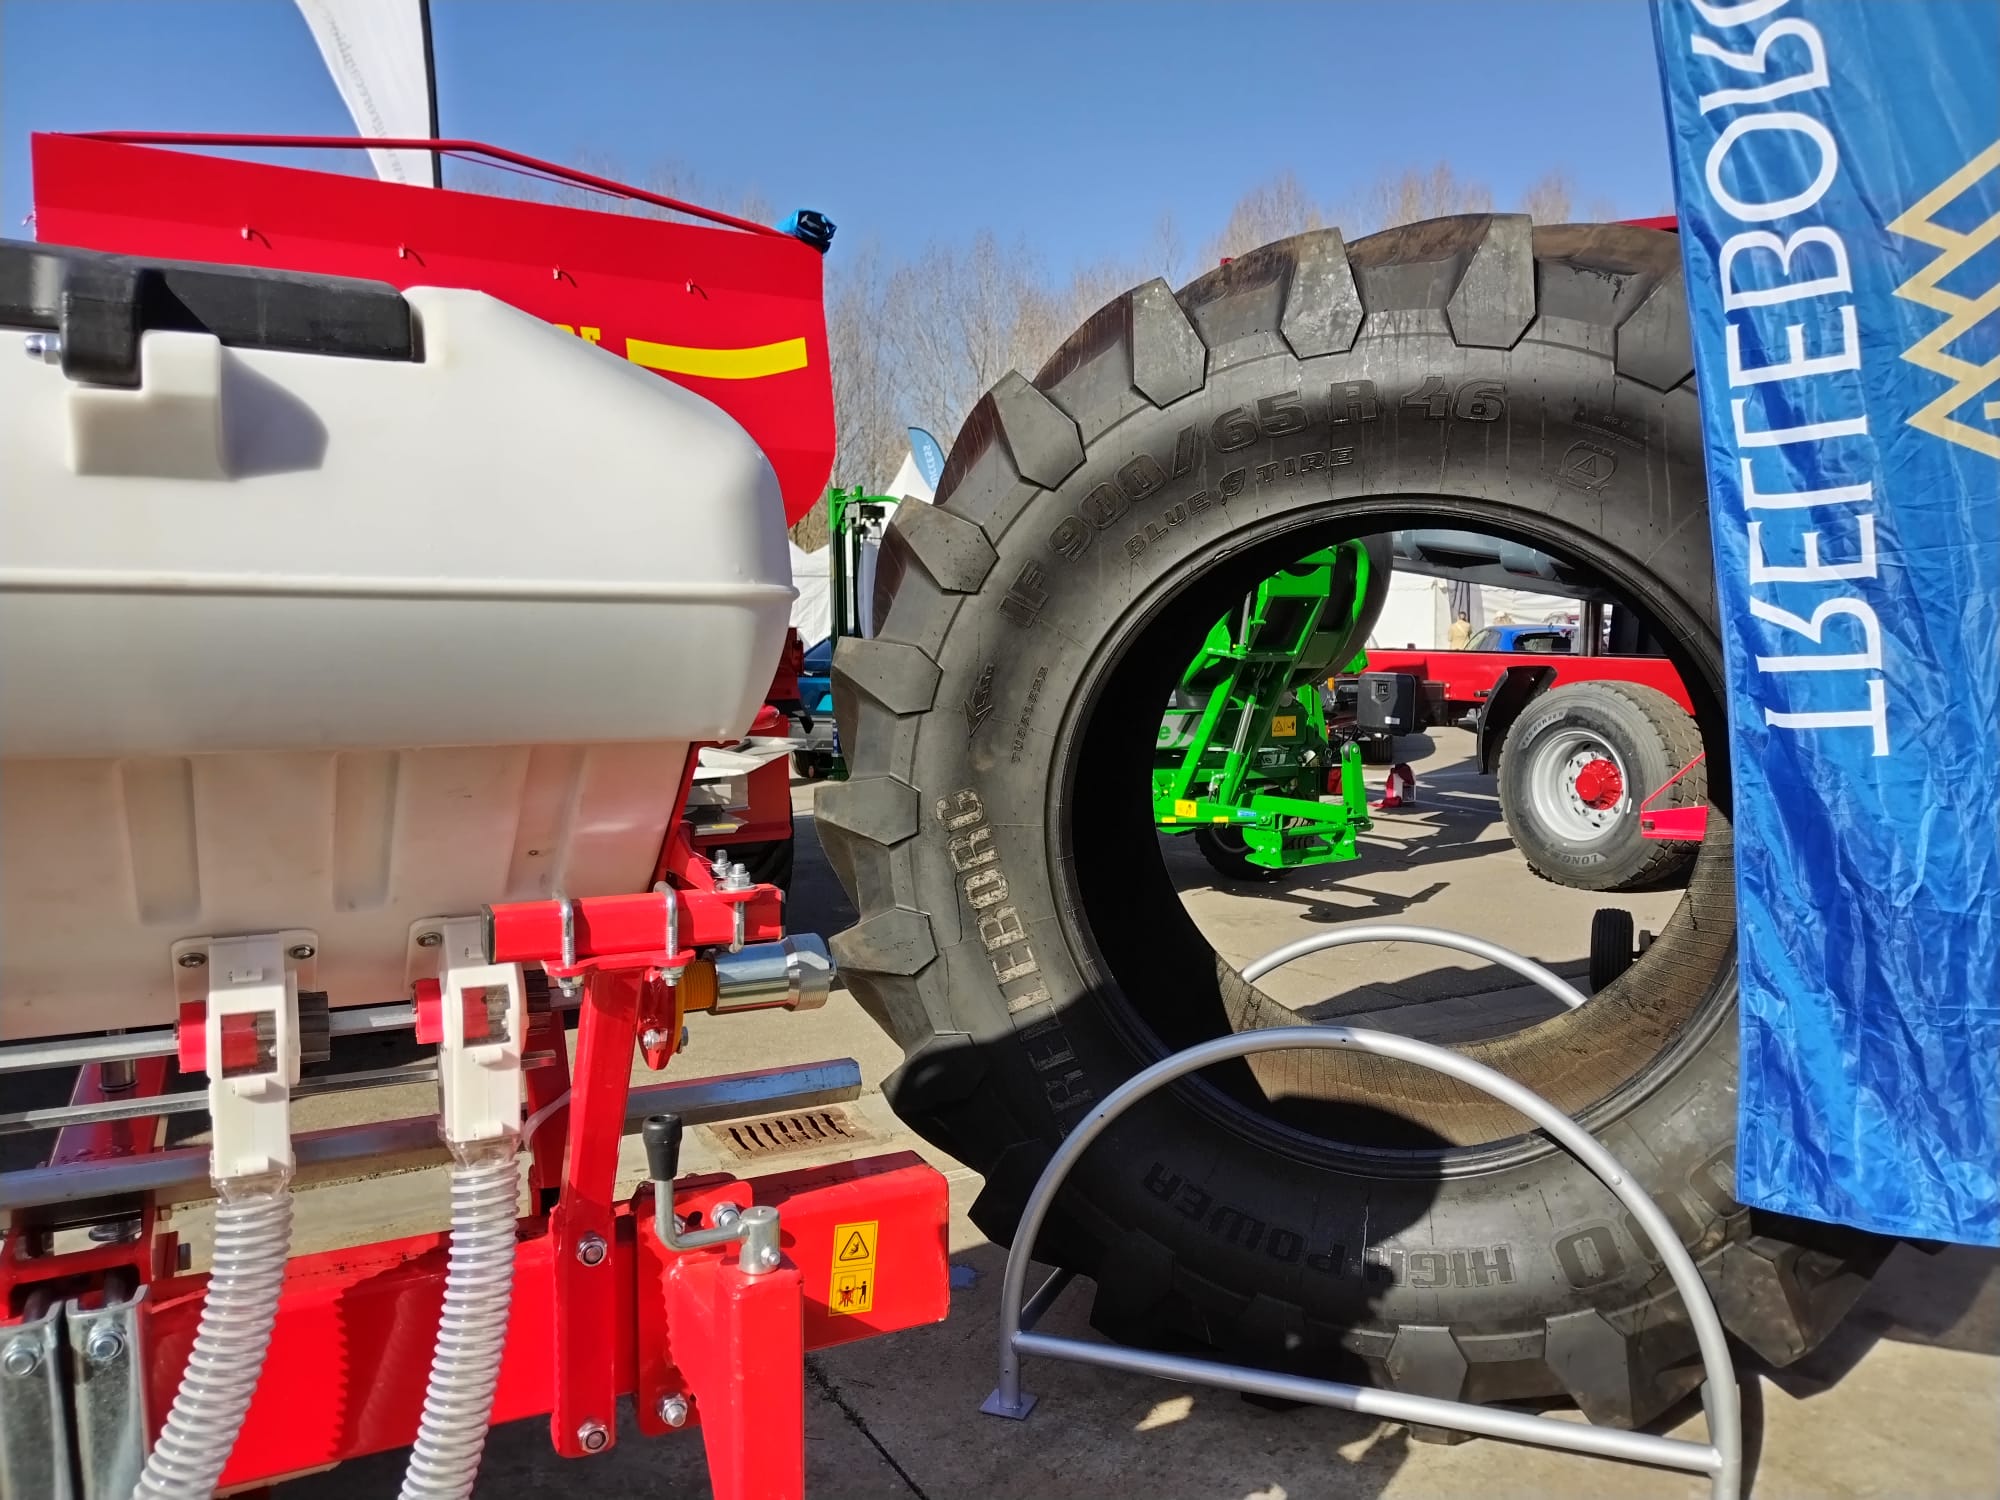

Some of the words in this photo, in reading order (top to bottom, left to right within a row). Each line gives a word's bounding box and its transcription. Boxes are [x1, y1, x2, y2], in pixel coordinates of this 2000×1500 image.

[1122, 489, 1212, 560] BLUE
[1255, 446, 1355, 485] TIRE
[935, 788, 1094, 1139] RELLEBORG
[1142, 1160, 1349, 1281] POWER
[1366, 1244, 1517, 1288] HIGH
